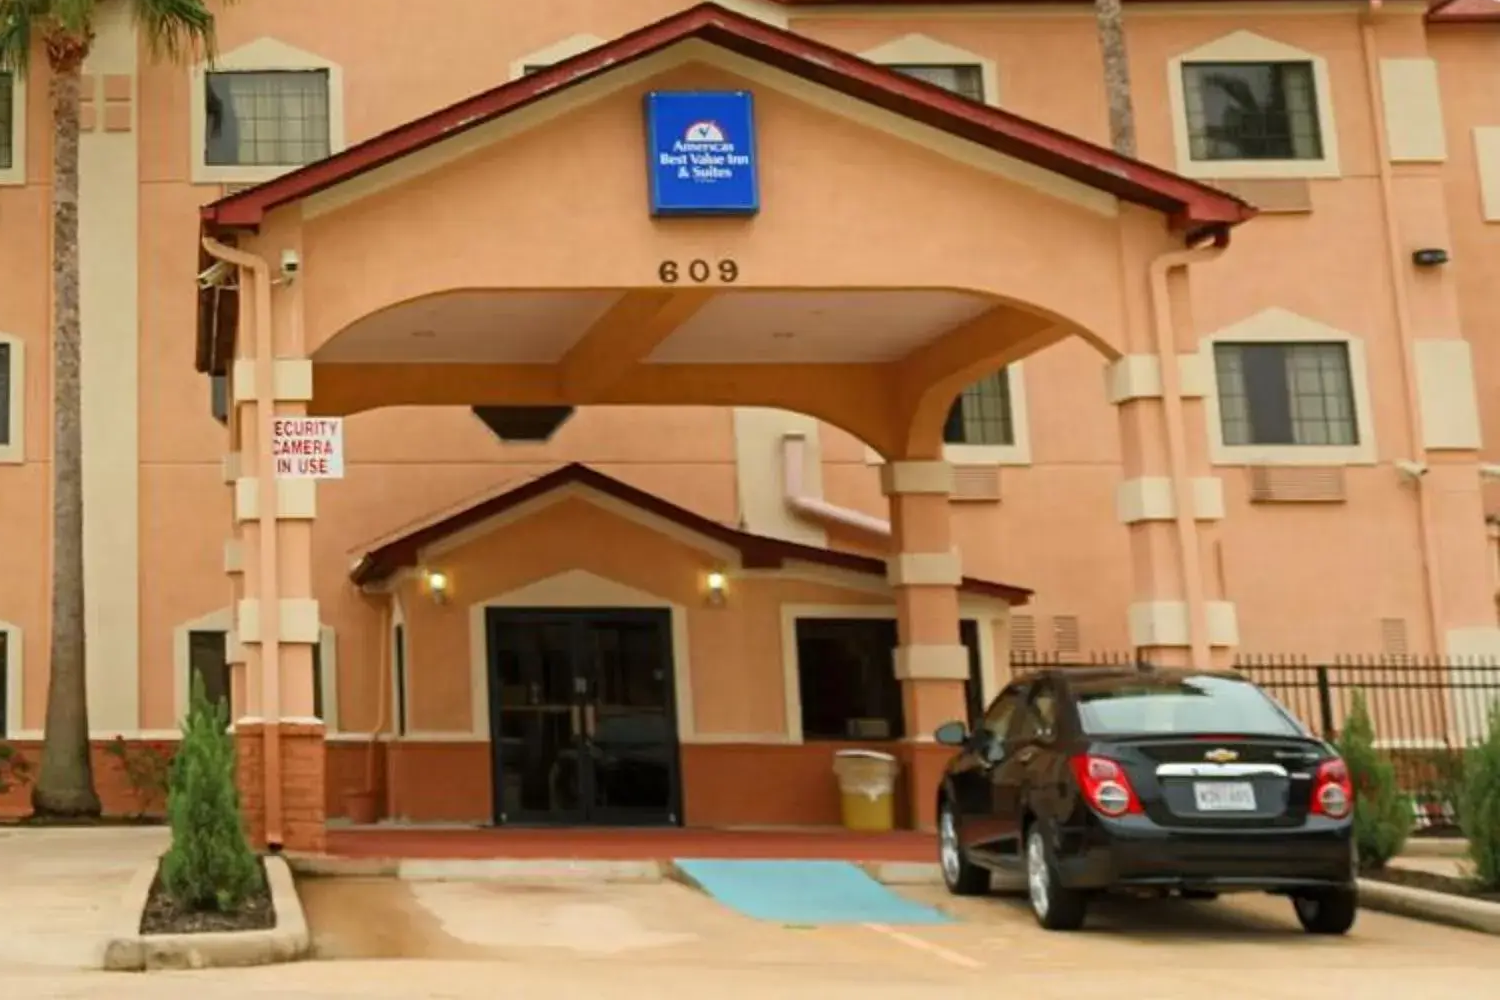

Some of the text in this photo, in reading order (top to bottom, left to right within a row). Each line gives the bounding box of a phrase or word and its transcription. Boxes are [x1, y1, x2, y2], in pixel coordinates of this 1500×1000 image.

[660, 153, 749, 165] Best Value Inn
[692, 166, 733, 179] Suites
[658, 259, 739, 283] 609
[274, 421, 338, 436] ECURITY
[277, 458, 328, 474] IN USE
